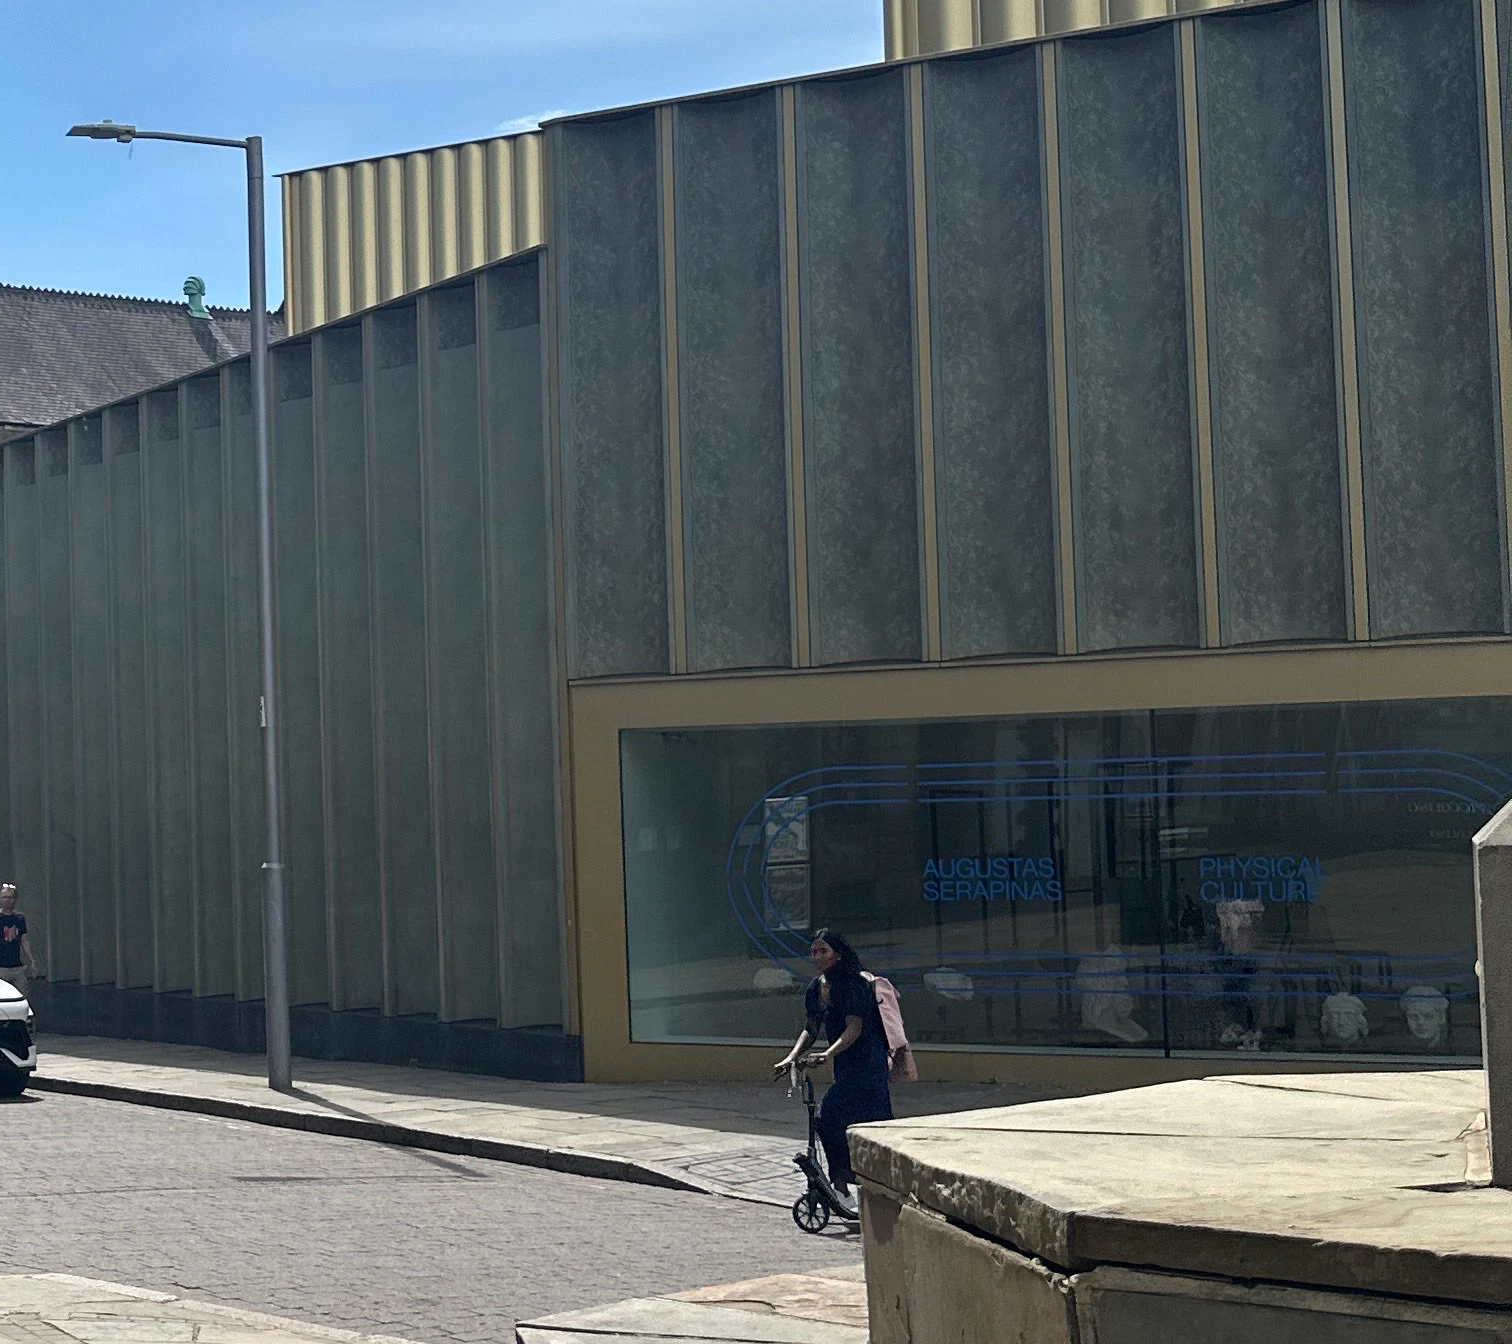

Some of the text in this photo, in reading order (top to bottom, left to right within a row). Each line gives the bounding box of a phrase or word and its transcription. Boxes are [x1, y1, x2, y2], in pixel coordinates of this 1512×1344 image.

[922, 857, 1055, 879] AUGUSTAS
[1199, 857, 1327, 881] PHYSICAL
[923, 880, 1063, 902] SERAPINAS
[1199, 880, 1321, 903] CULTURE
